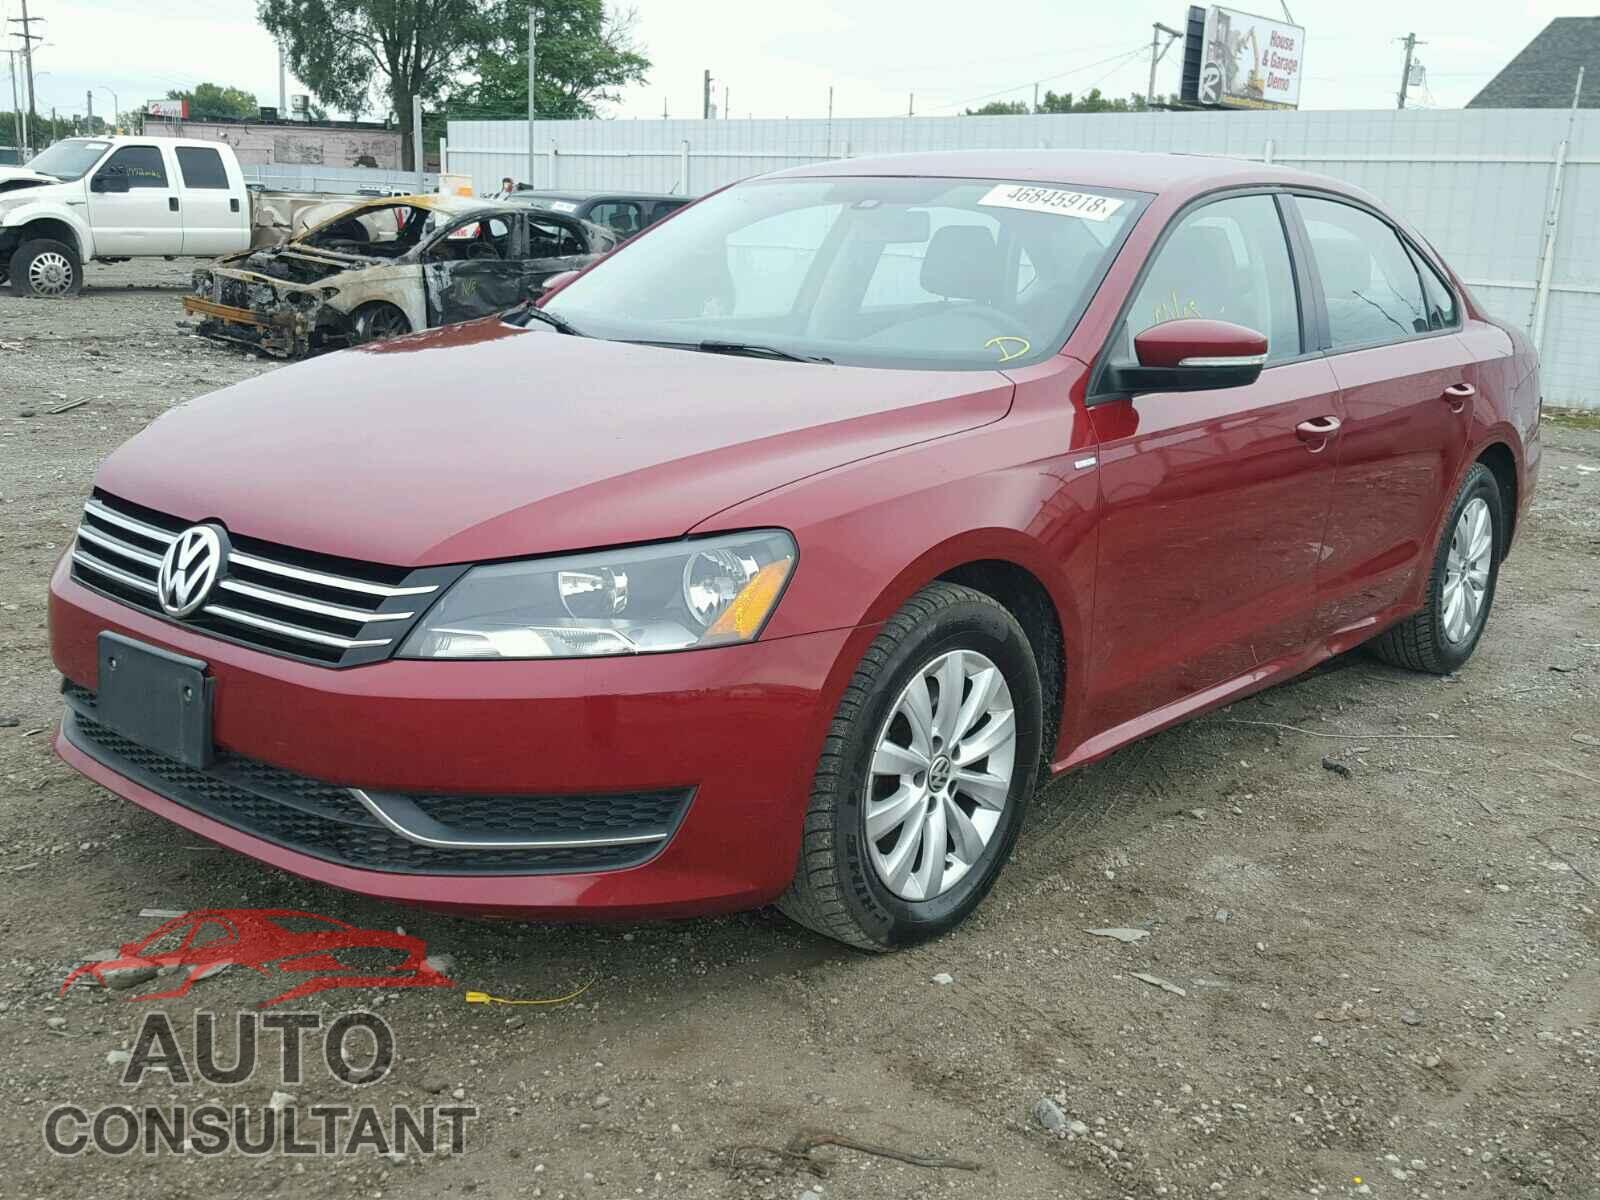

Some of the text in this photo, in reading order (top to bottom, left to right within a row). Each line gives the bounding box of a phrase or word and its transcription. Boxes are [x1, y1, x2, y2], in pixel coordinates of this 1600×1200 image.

[1270, 30, 1295, 51] House
[1262, 49, 1297, 75] & Garage
[1267, 72, 1289, 91] Demo
[984, 336, 1030, 362] D
